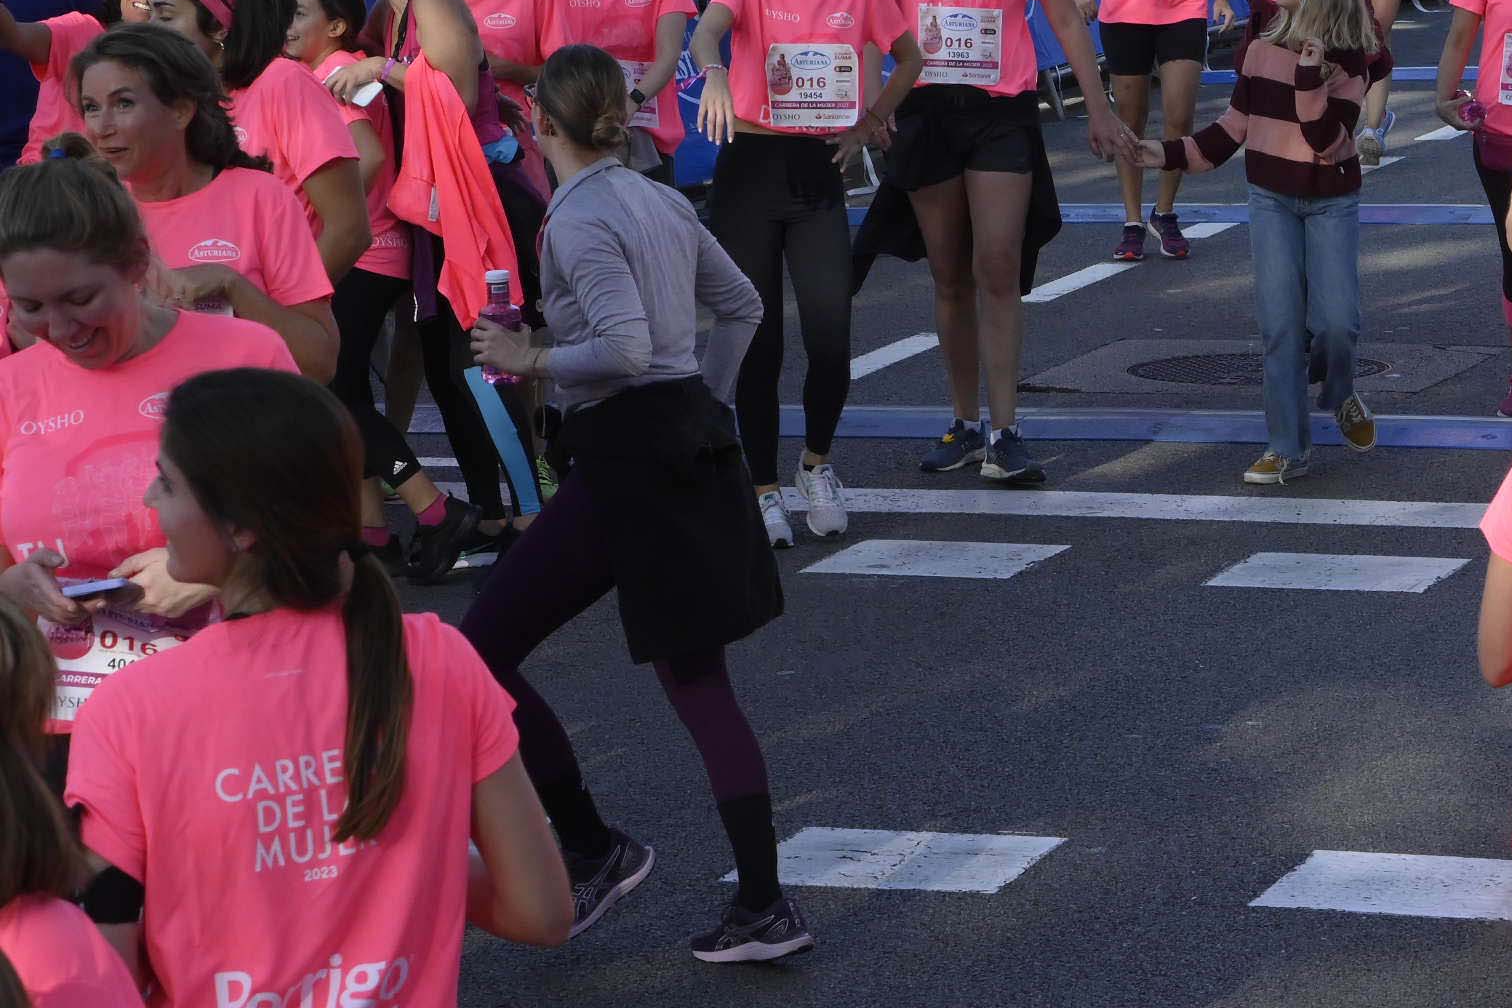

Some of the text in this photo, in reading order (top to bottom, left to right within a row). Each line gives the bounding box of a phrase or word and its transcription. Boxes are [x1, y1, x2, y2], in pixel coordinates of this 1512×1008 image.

[945, 37, 974, 49] 016
[795, 76, 827, 89] 016
[799, 91, 823, 100] 19454
[20, 409, 85, 435] OYSHO
[100, 629, 158, 656] 016
[258, 799, 305, 834] DE
[304, 865, 338, 882] 2023
